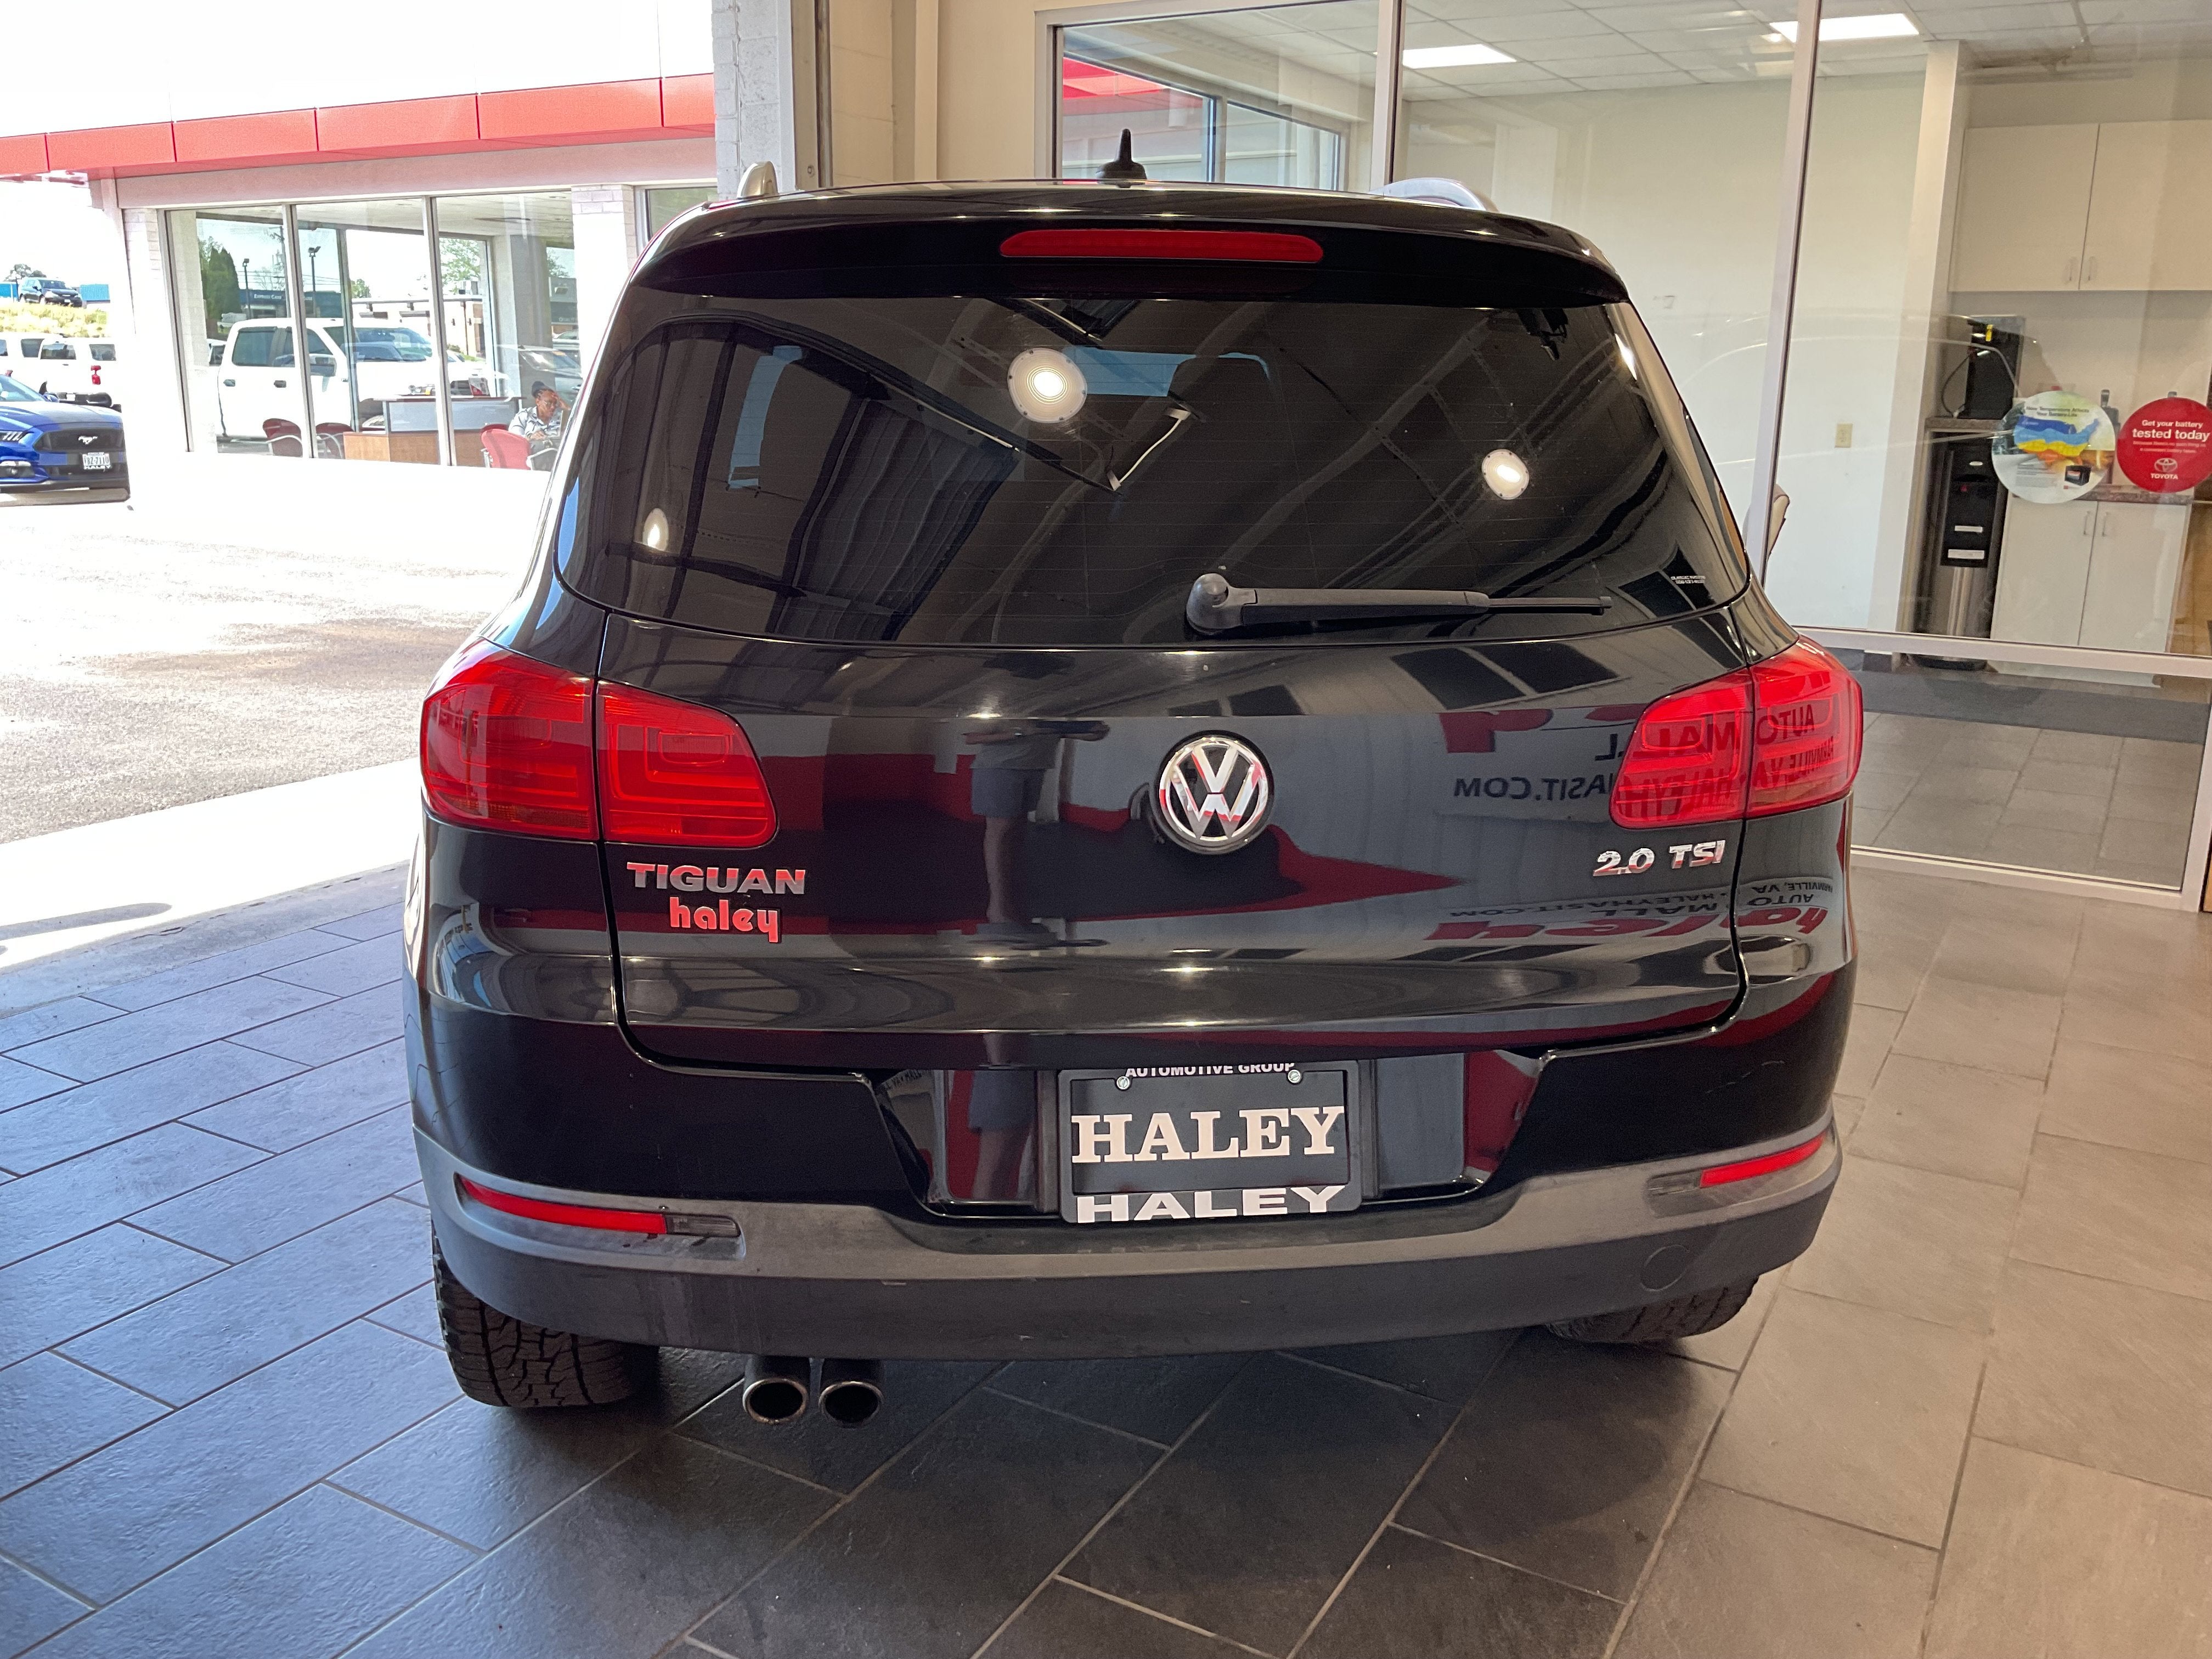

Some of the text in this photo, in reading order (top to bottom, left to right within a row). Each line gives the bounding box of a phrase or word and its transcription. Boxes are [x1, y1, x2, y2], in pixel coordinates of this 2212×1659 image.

[2132, 428, 2210, 442] tested today
[2175, 421, 2204, 429] battery
[1593, 840, 1726, 876] 2.0 TSI
[627, 862, 806, 895] TIGUAN
[669, 896, 779, 943] haley
[1071, 1105, 1345, 1163] HALEY
[1076, 1185, 1345, 1223] HALEY
